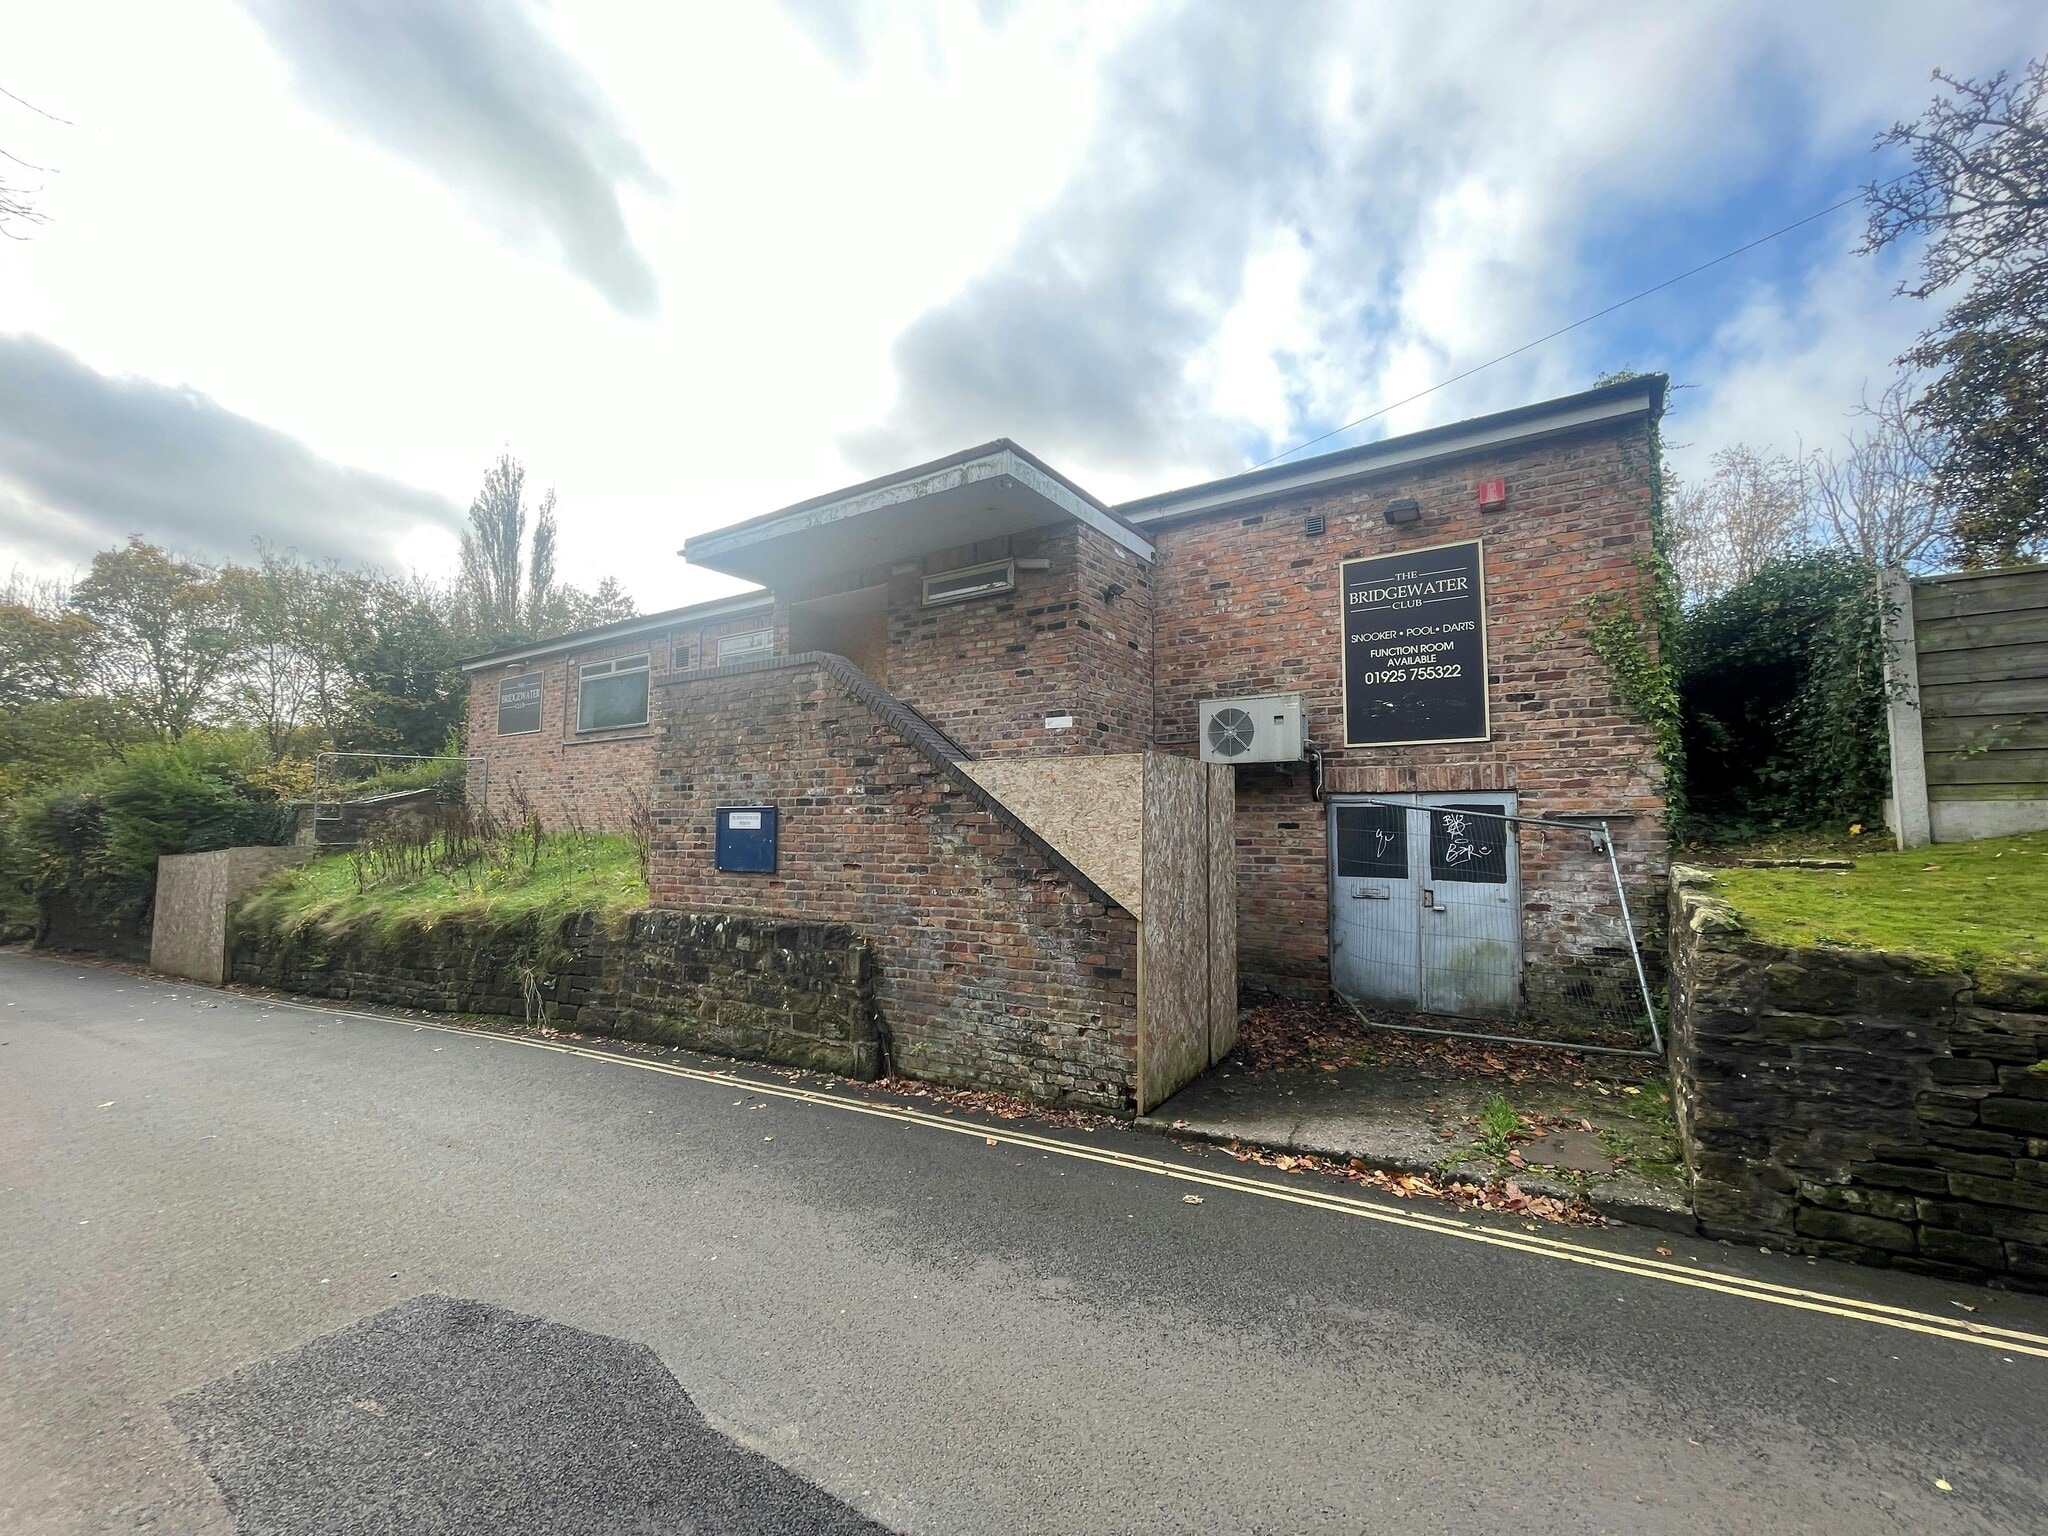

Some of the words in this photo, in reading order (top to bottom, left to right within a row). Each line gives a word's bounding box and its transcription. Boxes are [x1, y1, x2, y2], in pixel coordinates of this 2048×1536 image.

[1395, 571, 1418, 581] THE
[1349, 577, 1469, 605] BRIDGEWATER
[1392, 599, 1423, 610] CLUB
[1351, 630, 1397, 644] SNOOKER
[1406, 626, 1435, 637] POOL
[1443, 621, 1475, 634] DARTS
[1370, 645, 1419, 658] FUNCTION
[1420, 641, 1454, 653] ROOM
[1387, 654, 1437, 667] AVAILABLE
[1365, 670, 1407, 685] 01925
[1410, 664, 1461, 681] 755322
[501, 689, 540, 703] BRIDGEWATER
